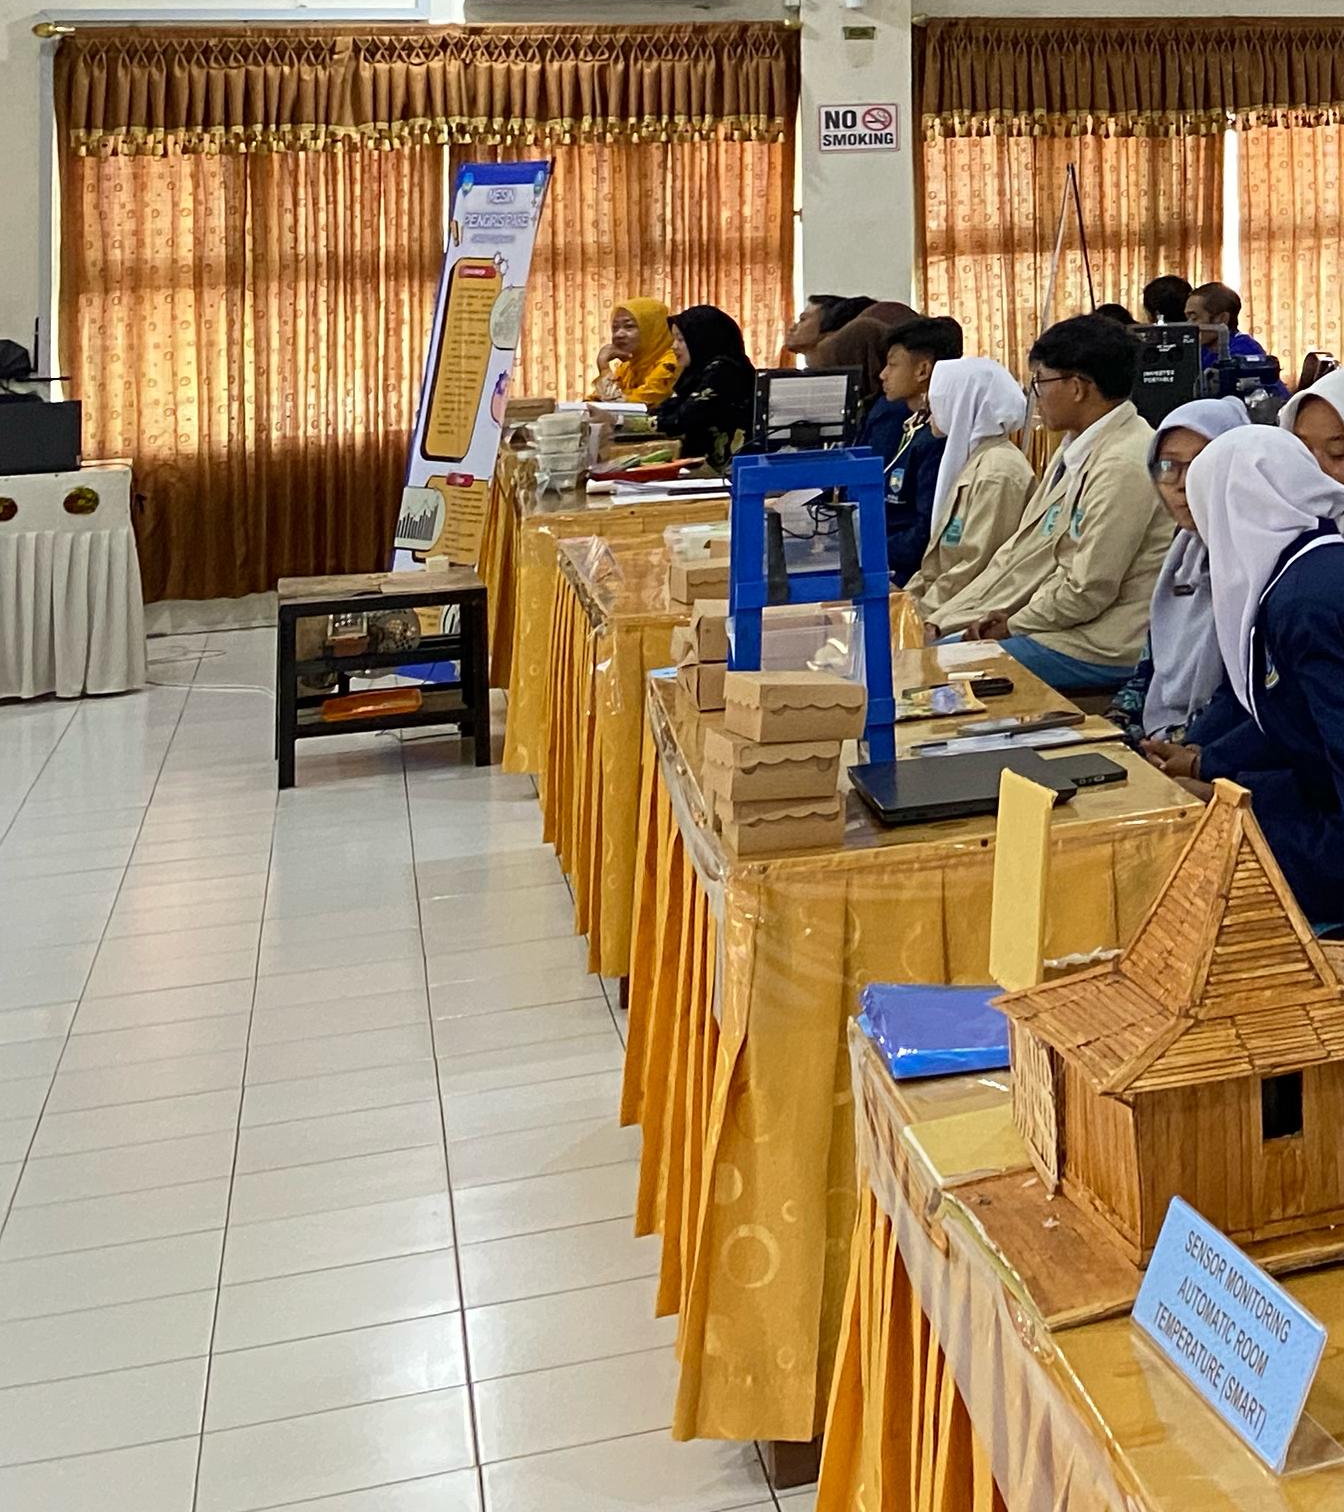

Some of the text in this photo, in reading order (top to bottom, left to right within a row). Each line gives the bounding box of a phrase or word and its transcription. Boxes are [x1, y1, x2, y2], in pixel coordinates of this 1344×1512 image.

[823, 132, 894, 147] SMOKING
[824, 110, 857, 129] NO
[1177, 1276, 1269, 1378] AUTOMATIC ROOM
[1185, 1230, 1291, 1344] SENSOR MONITORING
[1153, 1300, 1267, 1441] TEMPERATURE (SMART)
